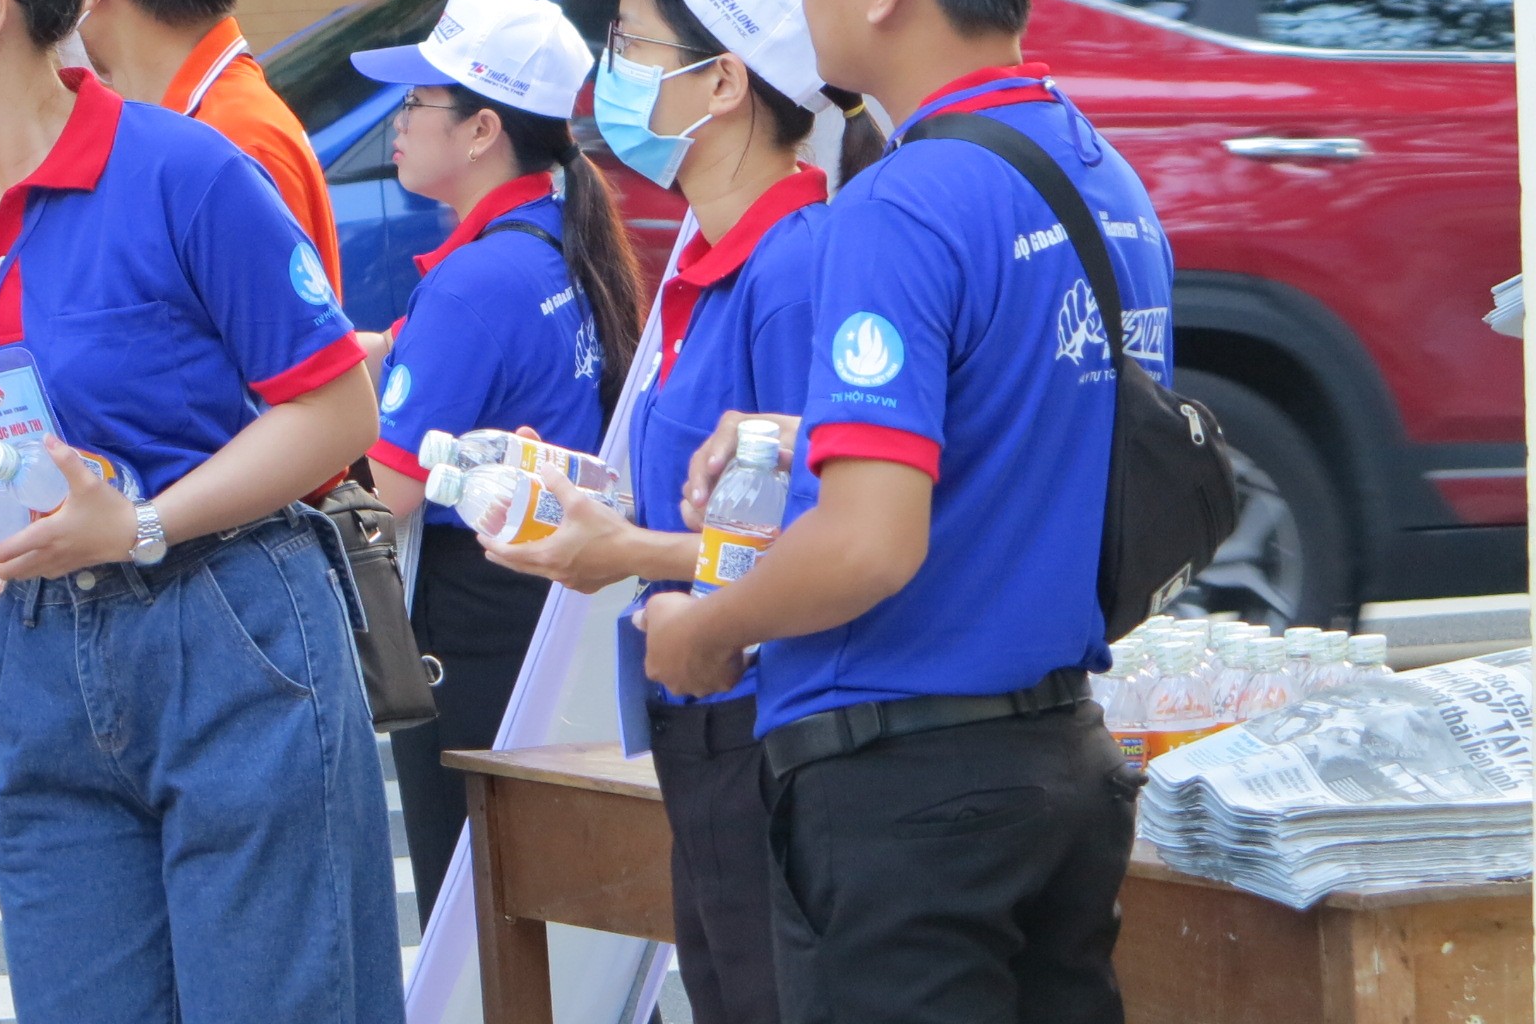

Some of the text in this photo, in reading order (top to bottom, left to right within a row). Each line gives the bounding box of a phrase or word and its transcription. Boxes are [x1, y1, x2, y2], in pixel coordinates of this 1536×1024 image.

[732, 8, 760, 36] LONG
[509, 78, 531, 93] LONG
[844, 390, 865, 404] HỘI
[865, 393, 880, 405] SV
[880, 396, 898, 409] VN
[27, 417, 44, 432] THI
[1438, 704, 1482, 743] thải
